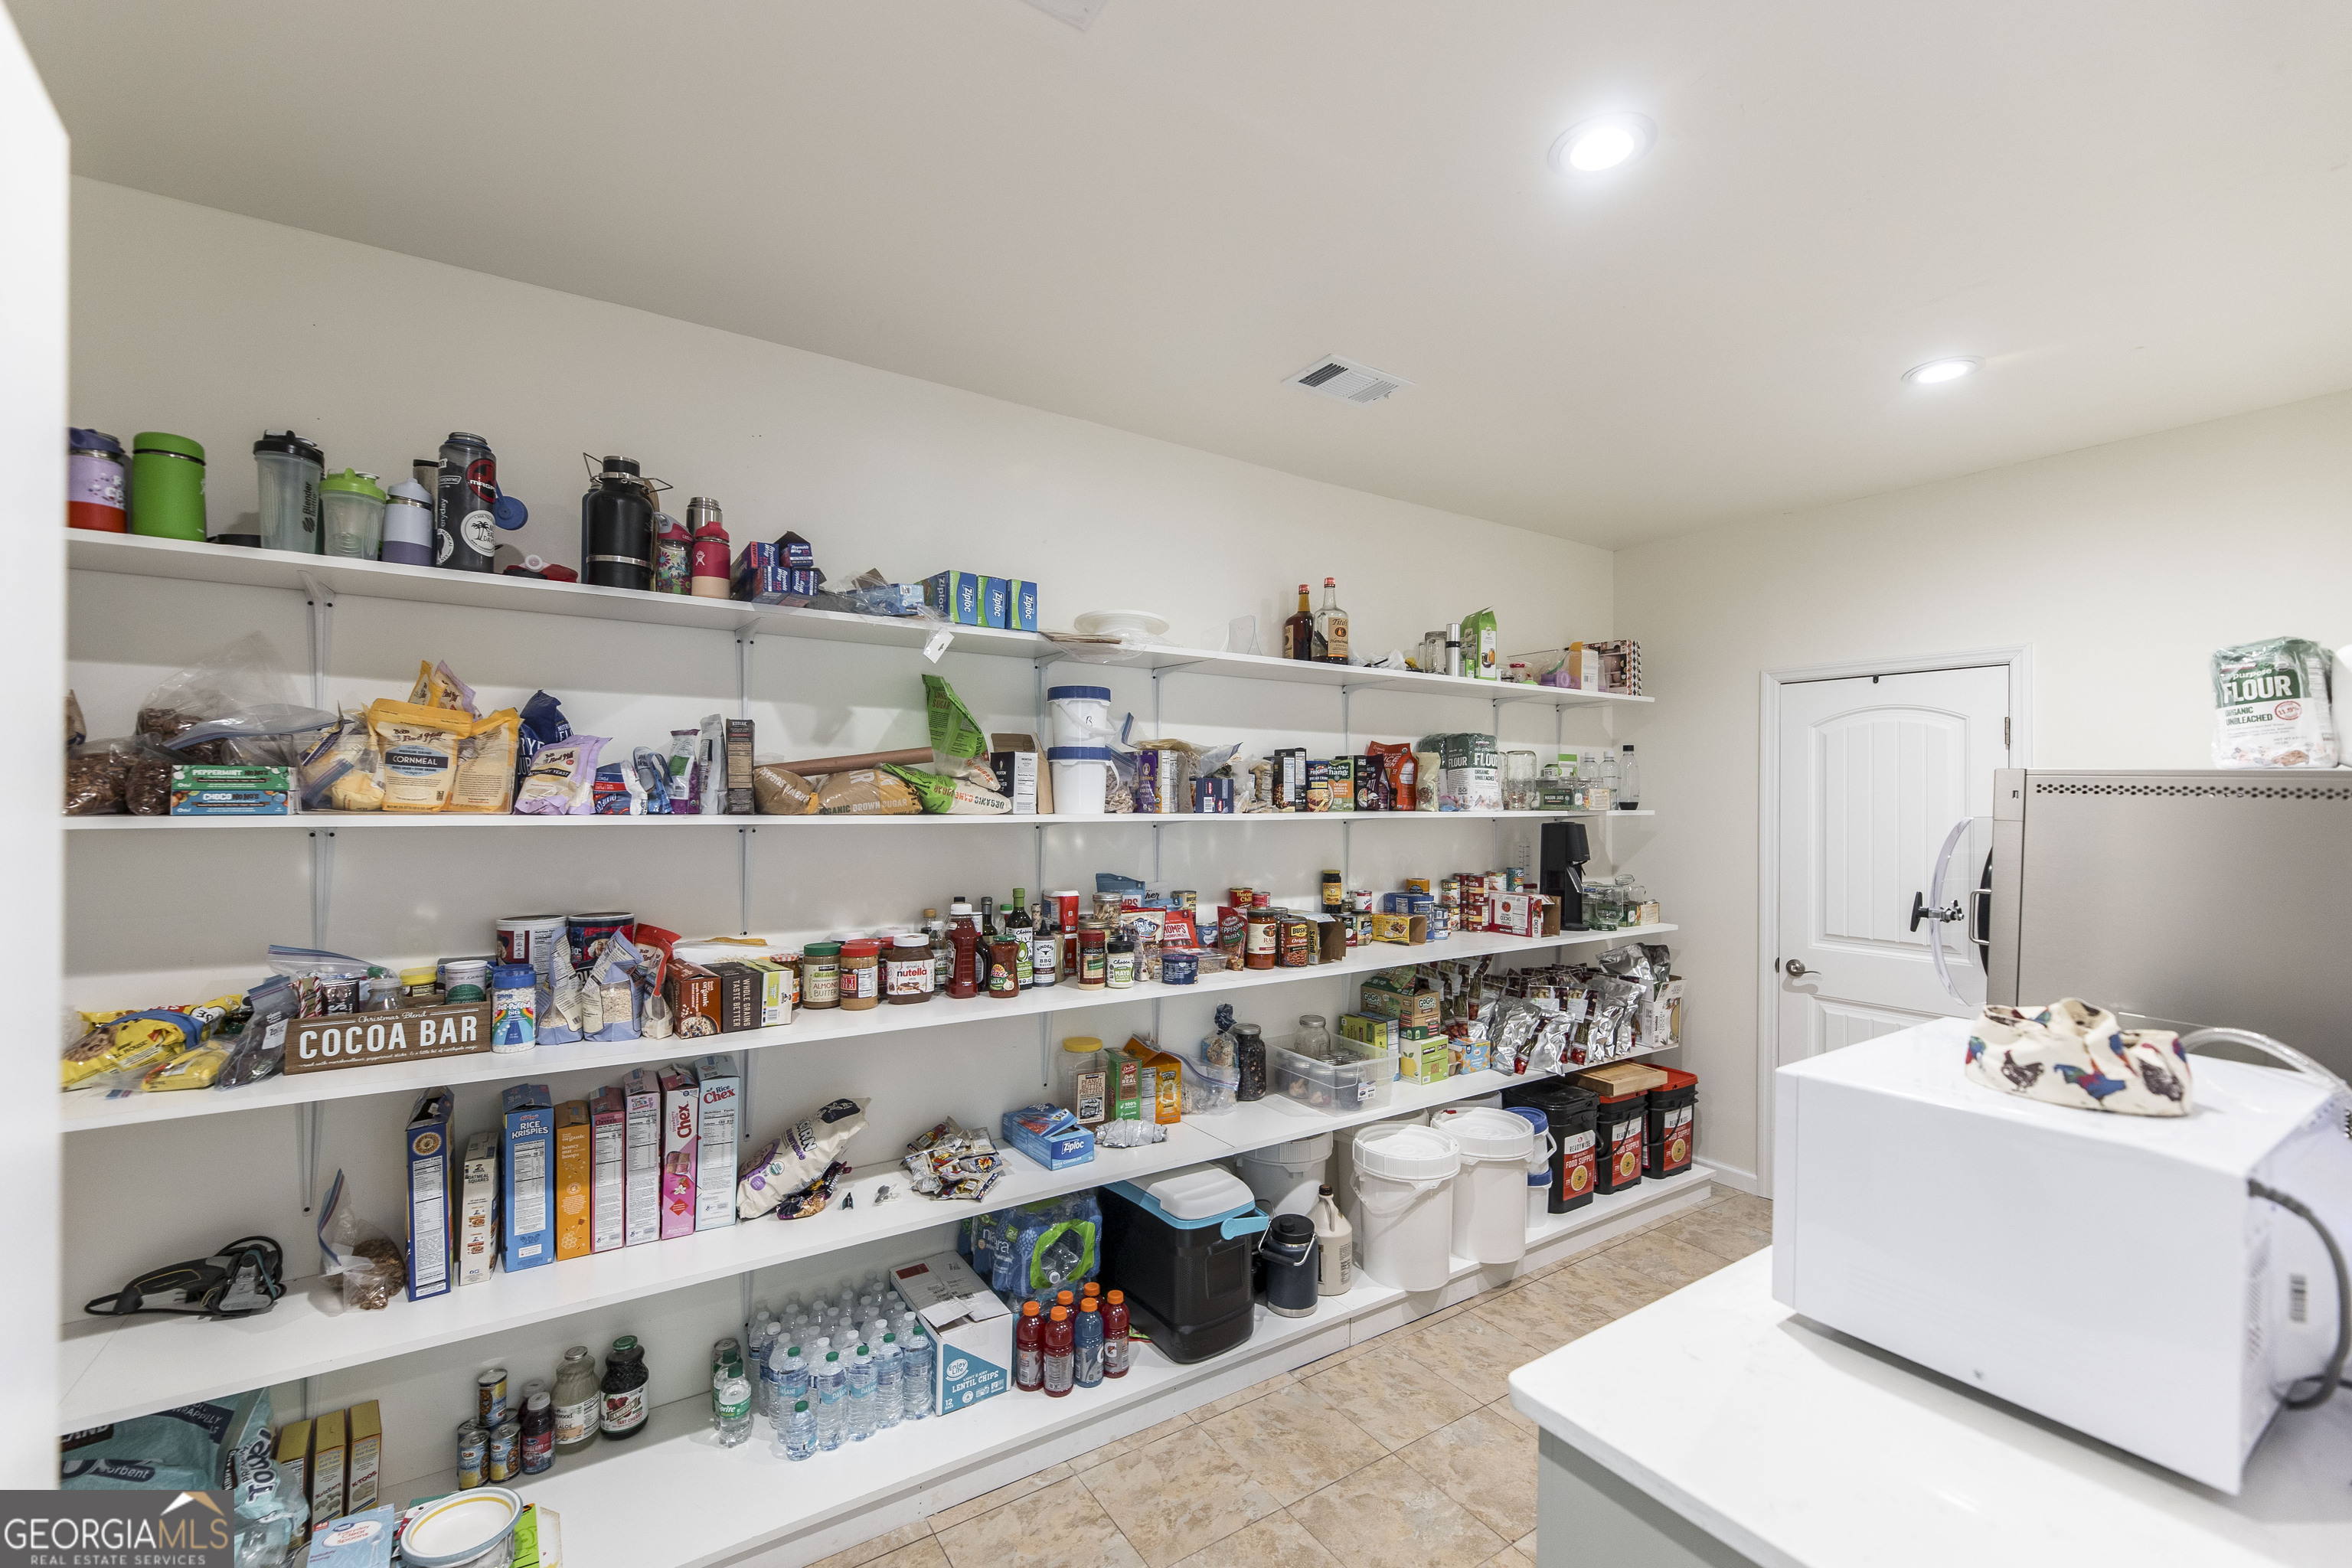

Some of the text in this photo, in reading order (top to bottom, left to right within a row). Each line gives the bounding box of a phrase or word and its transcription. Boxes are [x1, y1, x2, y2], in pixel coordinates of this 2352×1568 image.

[962, 586, 972, 612] Ziploc
[995, 592, 1003, 617] Ziploc
[1025, 594, 1034, 619] Ziploc
[2233, 668, 2272, 680] purpose
[2223, 675, 2292, 704] FLOUR
[932, 700, 950, 710] SUGAR
[2225, 707, 2253, 717] ORGANIC
[2226, 714, 2272, 726] UNBLEACHED
[393, 756, 437, 766] CORNMEAL
[1449, 756, 1467, 767] FLOUR
[974, 765, 994, 783] SUGAR
[761, 767, 809, 803] BROWN SUGAR
[853, 799, 907, 812] BROWN SUGAR
[974, 795, 1004, 809] ORGANIC
[897, 967, 926, 977] nutella
[497, 1001, 531, 1011] Jet-Puffed
[1419, 998, 1433, 1008] GoGo
[358, 1011, 427, 1024] Christmas Blend
[299, 1015, 478, 1060] COCOA BAR
[124, 1040, 149, 1054] HOUSE
[716, 1084, 730, 1093] Rice
[703, 1088, 736, 1104] Chex
[520, 1120, 541, 1130] RICE
[677, 1102, 691, 1138] Chex
[511, 1126, 550, 1139] KRISPIES
[1677, 1129, 1690, 1138] SUPPLY
[1063, 1140, 1084, 1152] Ziploc
[1570, 1141, 1591, 1152] READYWISE
[1626, 1141, 1639, 1151] SUPPLY
[1566, 1154, 1593, 1168] FOOD SUPPLY
[1104, 1341, 1117, 1358] G
[949, 1361, 966, 1370] Enjoy
[952, 1370, 998, 1393] LENTIL CHIPS
[610, 1399, 638, 1420] KNUDSEN
[628, 1413, 642, 1423] CHERRY
[351, 1470, 377, 1488] K-TOOS
[337, 1532, 369, 1544] Spoons
[341, 1530, 366, 1539] Clear
